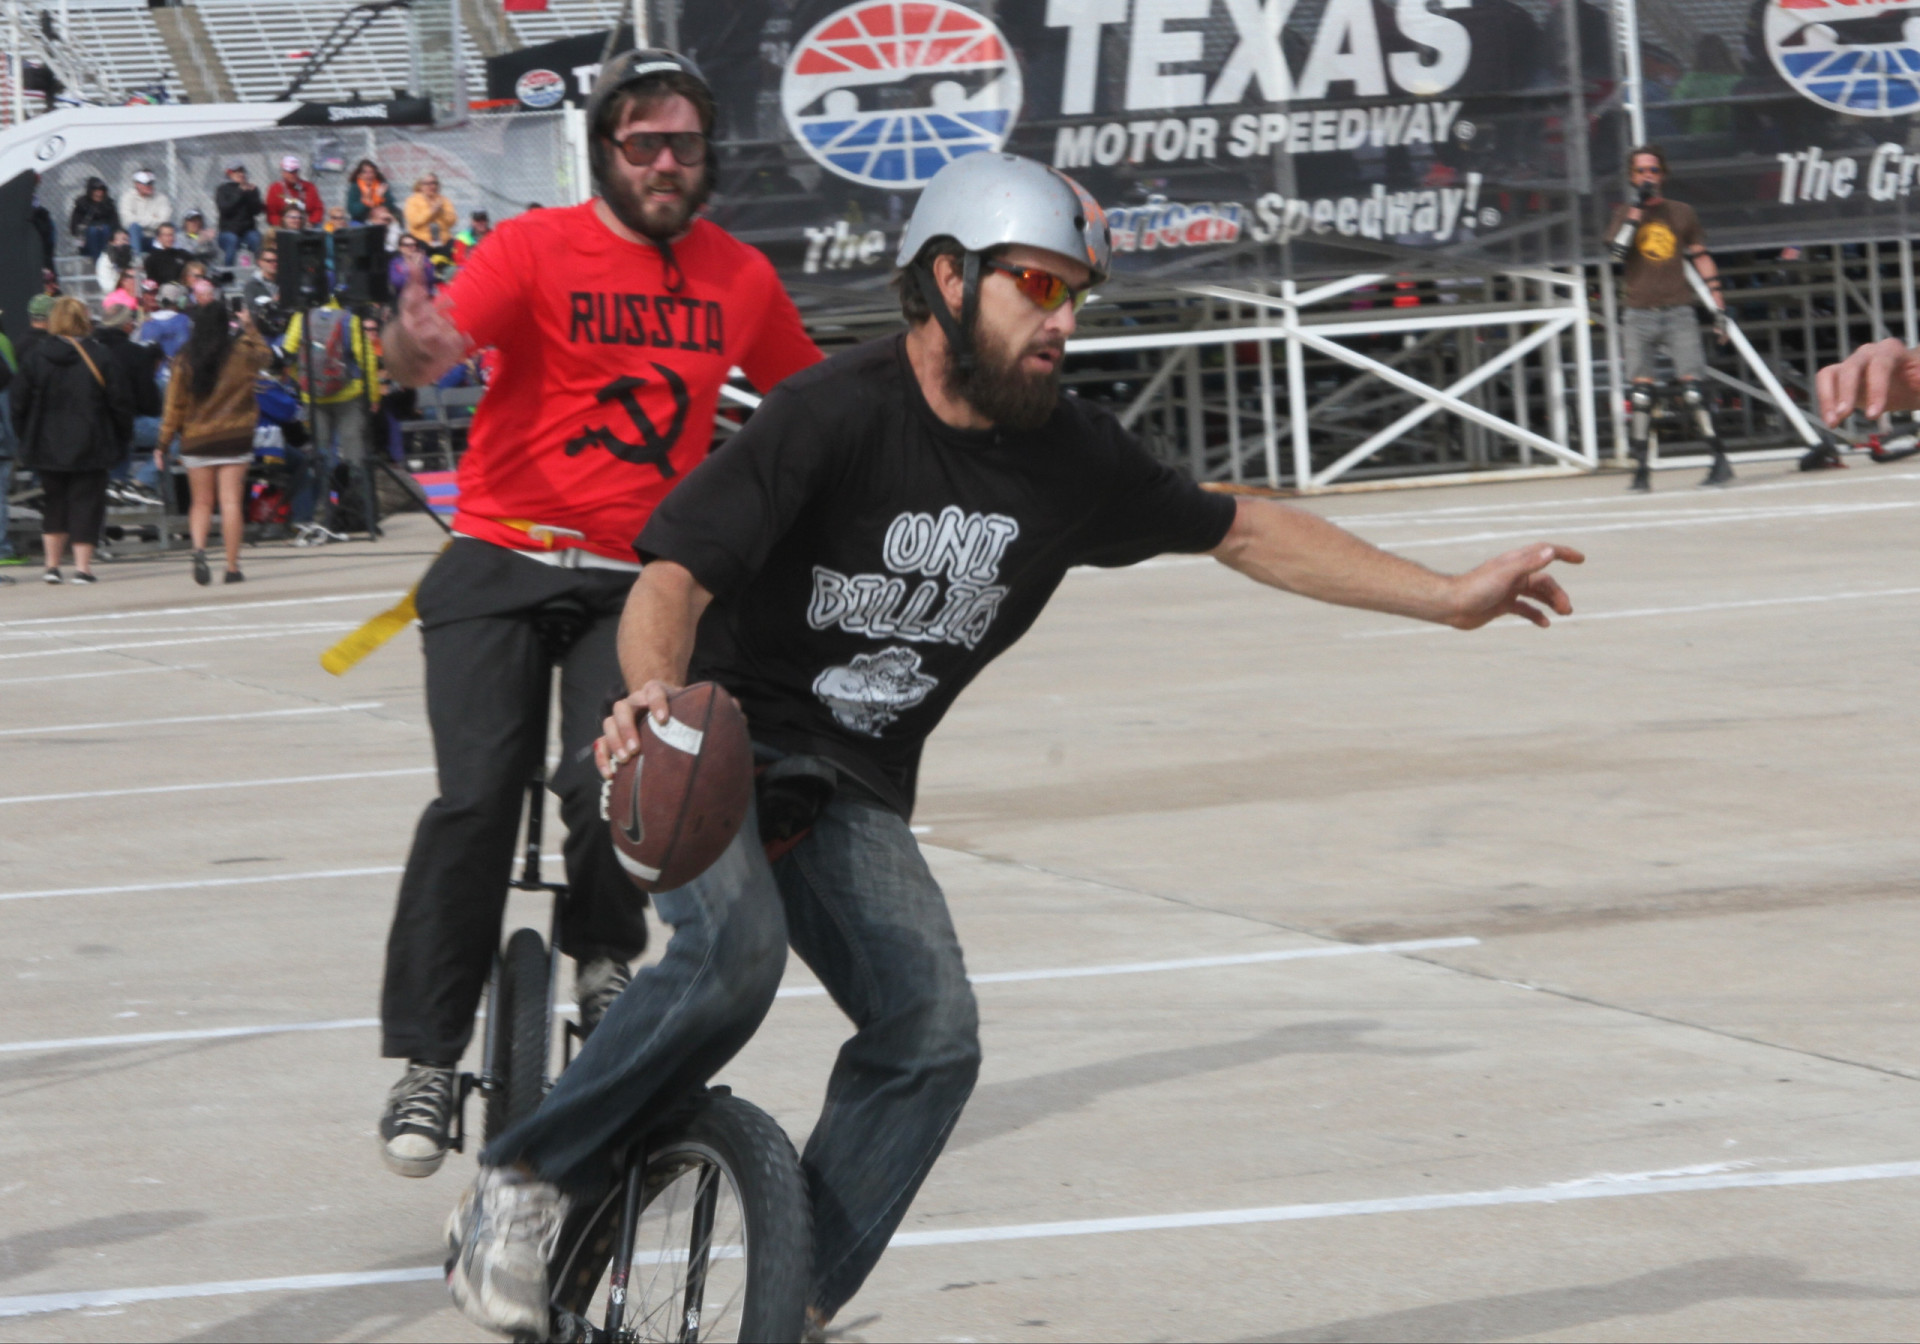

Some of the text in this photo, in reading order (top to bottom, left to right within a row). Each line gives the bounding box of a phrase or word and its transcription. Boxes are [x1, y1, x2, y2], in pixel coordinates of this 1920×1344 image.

[1044, 0, 1473, 115] TEXAS
[1053, 117, 1219, 169] MOTOR
[1776, 142, 1920, 205] The Gr
[803, 220, 886, 274] The
[1104, 194, 1242, 252] erican
[569, 291, 725, 355] RUSSIA
[883, 504, 1020, 585] UNI
